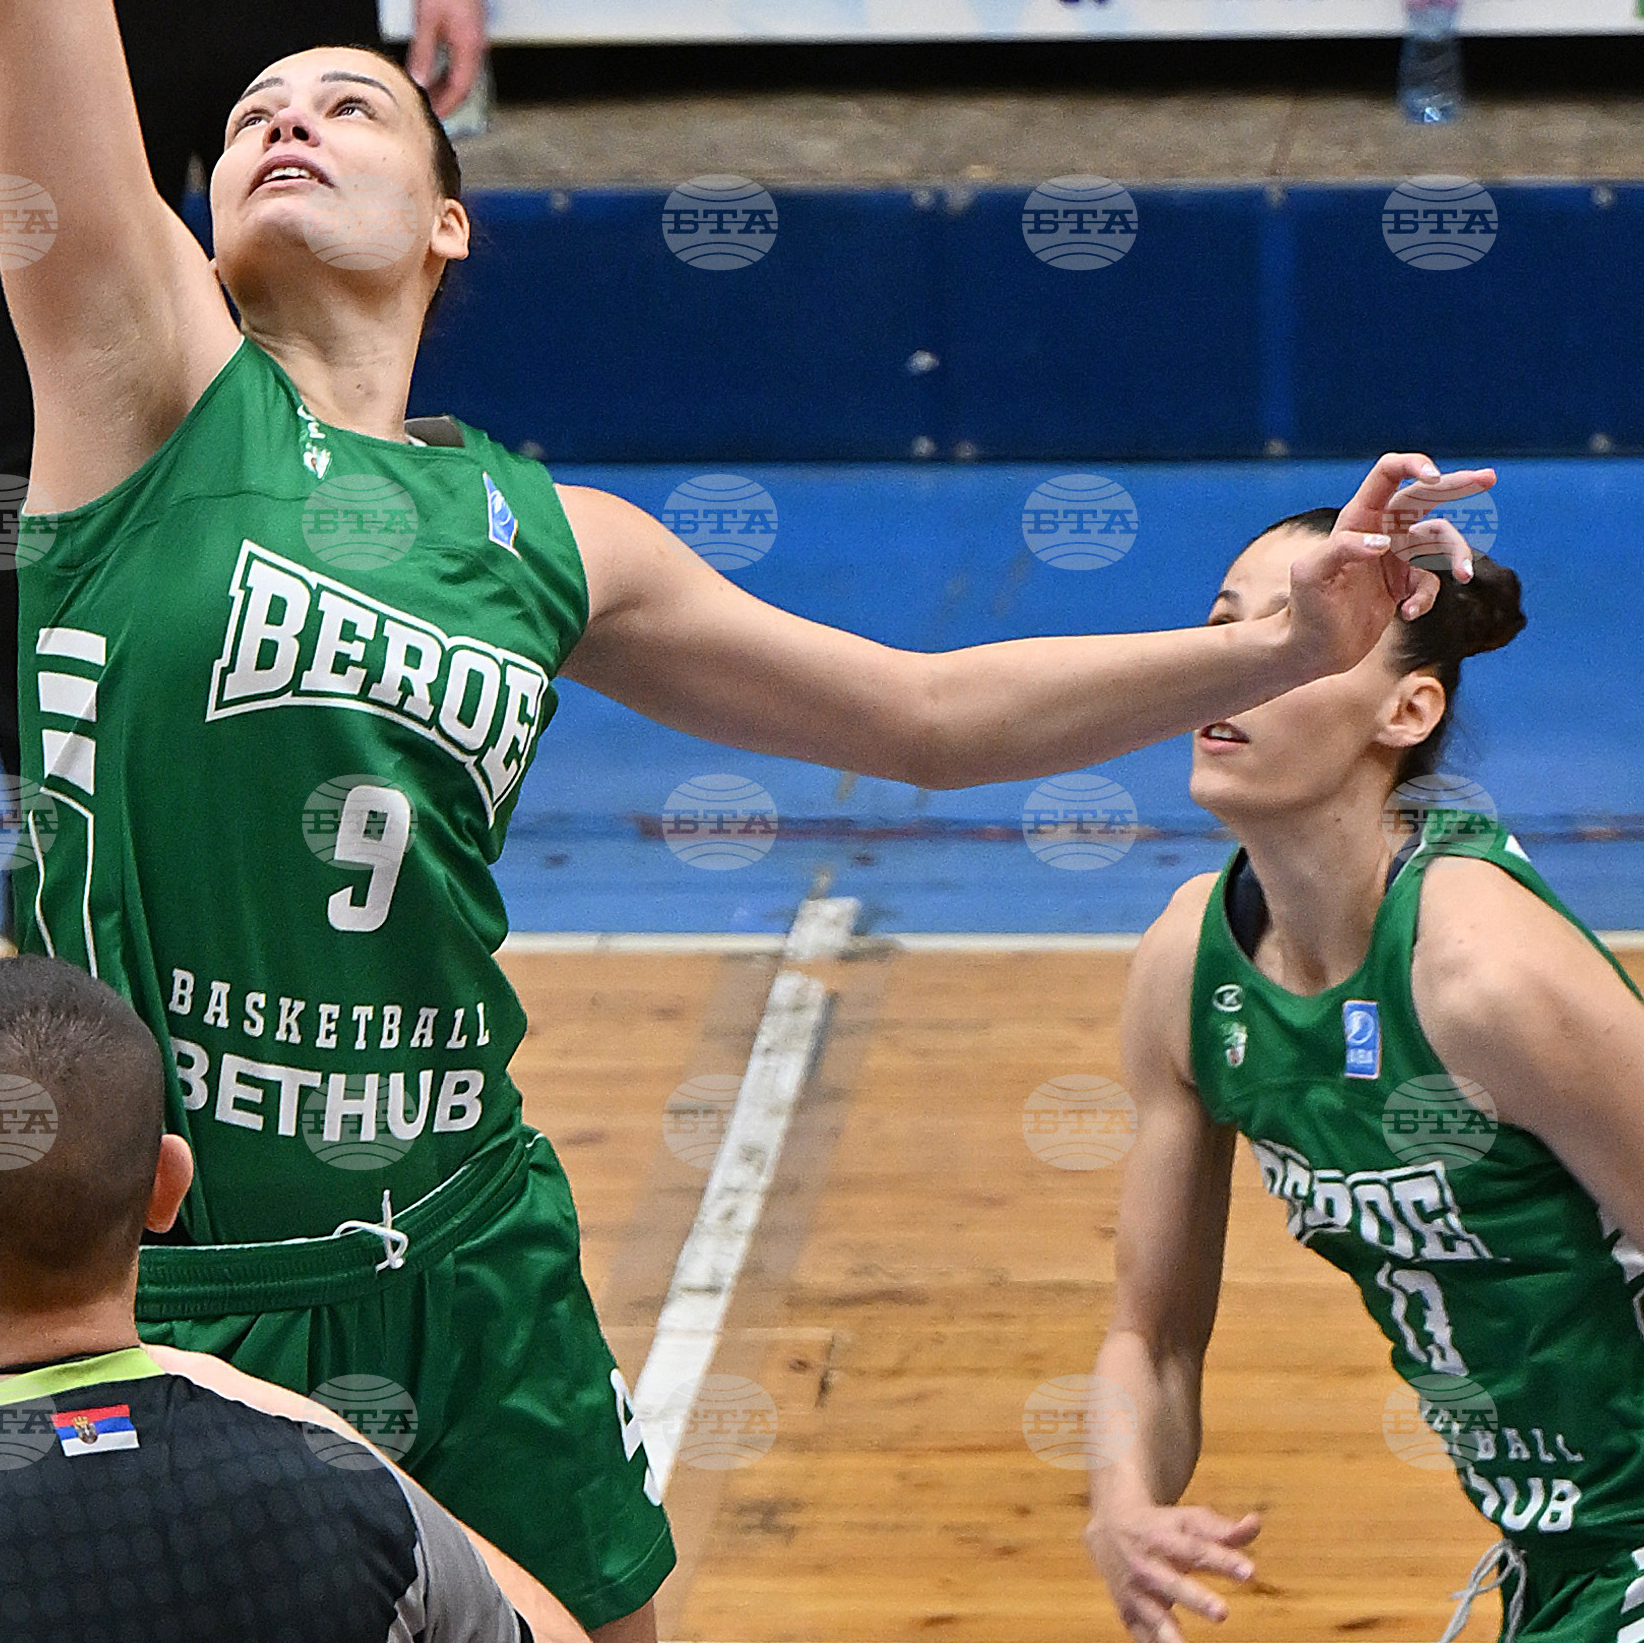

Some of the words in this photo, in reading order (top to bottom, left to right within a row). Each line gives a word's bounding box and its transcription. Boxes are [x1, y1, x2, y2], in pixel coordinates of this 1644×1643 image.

[212, 546, 549, 813] BEROE
[327, 784, 412, 932] 9
[168, 967, 490, 1050] BASKETBALL
[170, 1035, 485, 1143] BETHUB
